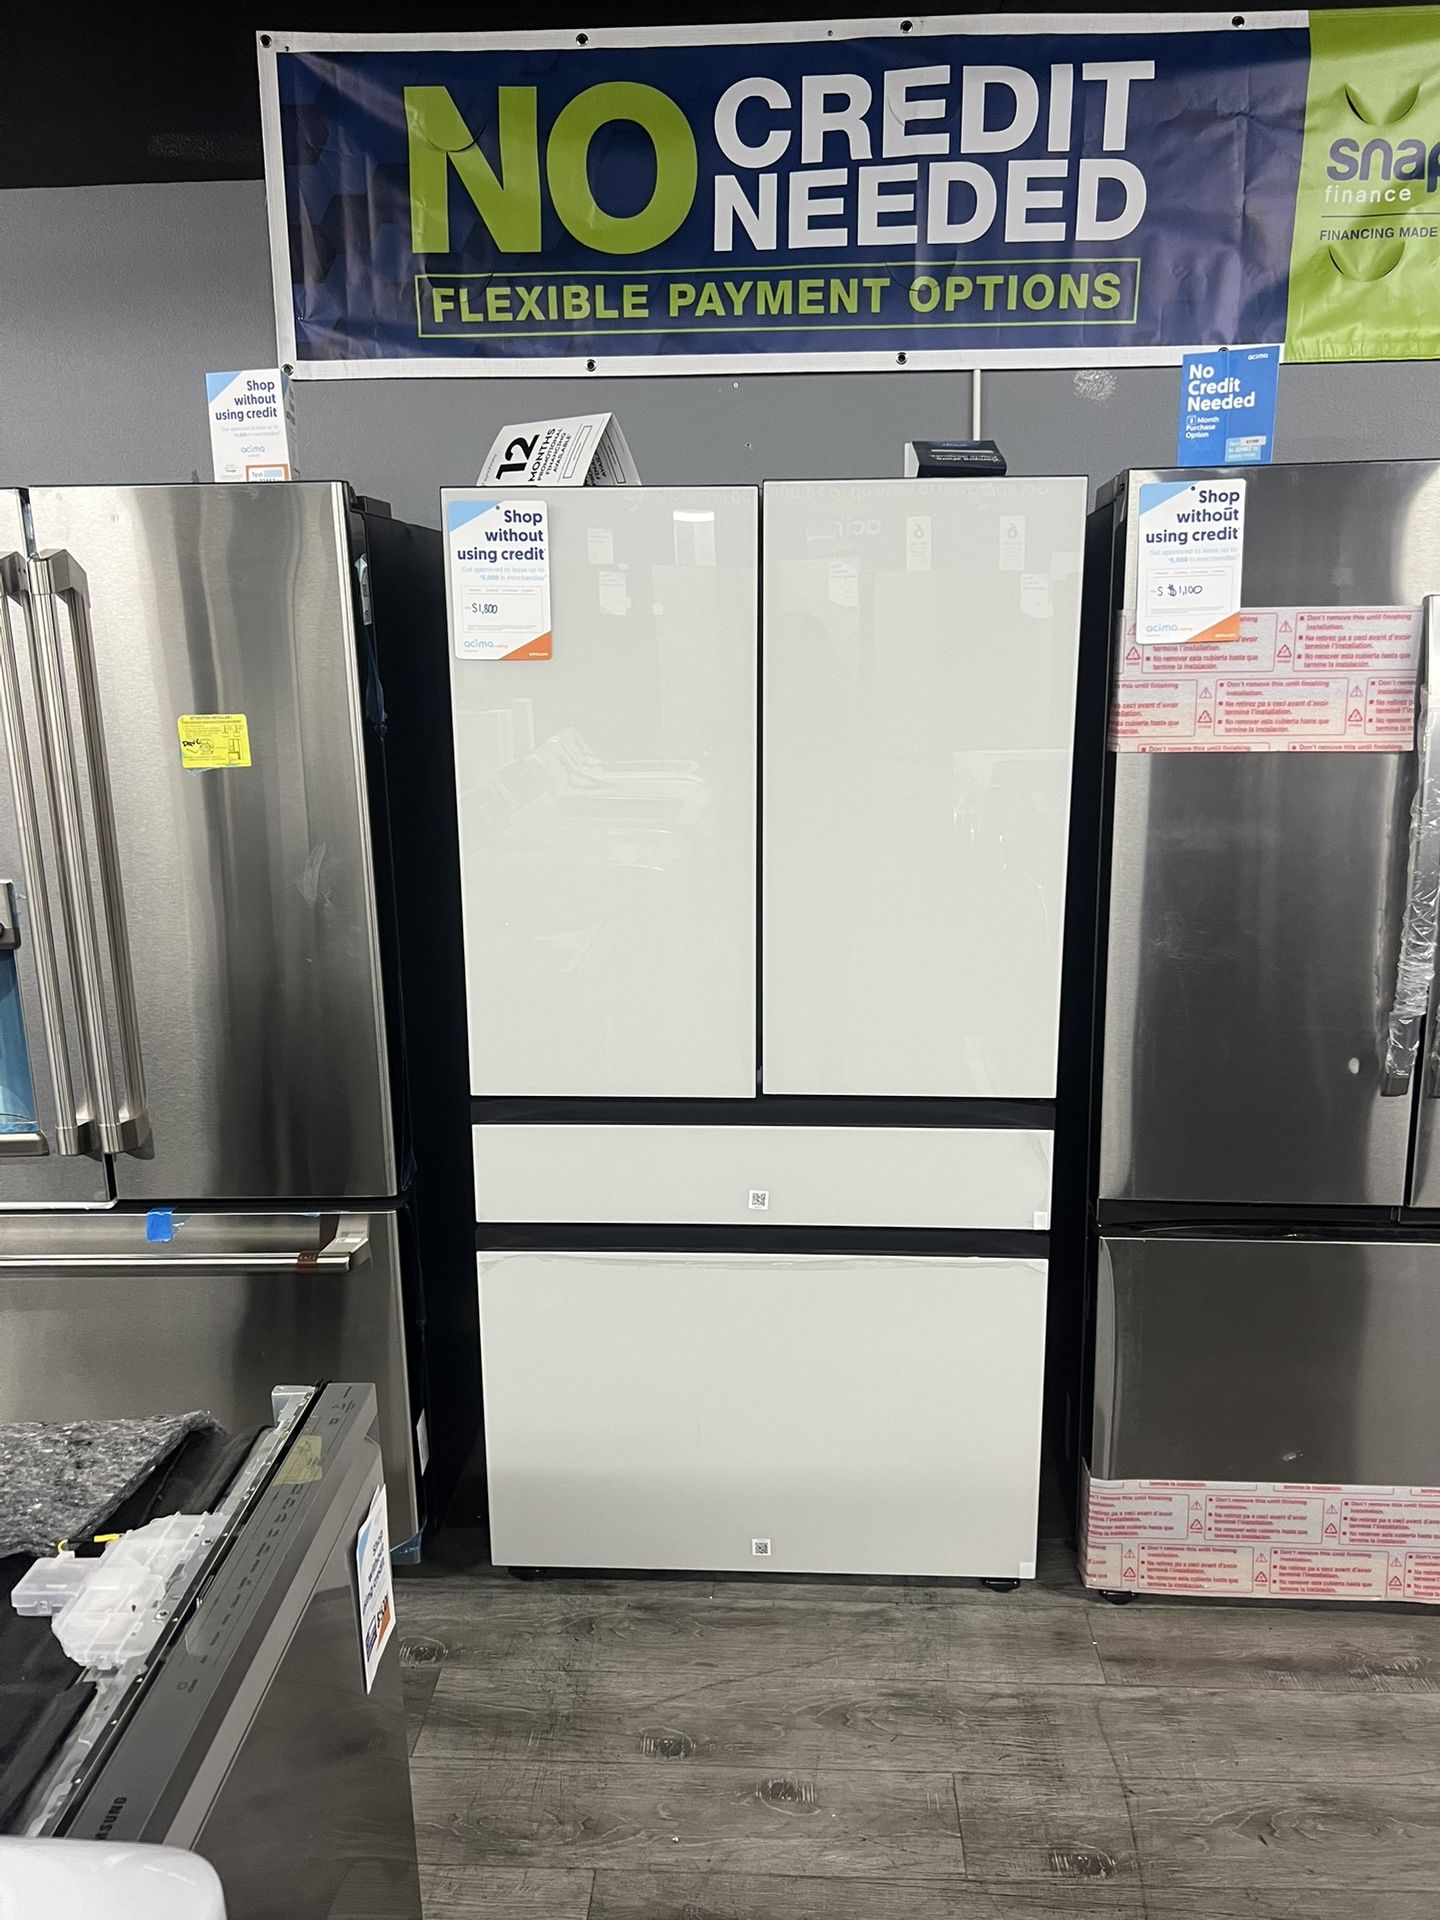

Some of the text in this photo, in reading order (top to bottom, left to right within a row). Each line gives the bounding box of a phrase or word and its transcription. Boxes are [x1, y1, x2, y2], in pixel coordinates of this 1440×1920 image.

[714, 60, 1156, 169] CREDIT
[404, 81, 698, 255] NO
[1325, 185, 1412, 203] finance
[714, 158, 1148, 252] NEEDED
[1320, 226, 1438, 241] FINANCING MADE
[432, 272, 1122, 324] FLEXIBLE PAYMENT OPTIONS
[1189, 363, 1215, 380] No
[246, 380, 275, 393] Shop
[1188, 377, 1241, 396] Credit
[234, 394, 277, 406] without
[1187, 391, 1256, 412] Needed
[215, 407, 278, 422] using credit
[240, 444, 265, 454] acima
[495, 434, 540, 480] 12
[528, 428, 556, 482] MONTHS
[1199, 490, 1240, 506] Shop
[504, 510, 543, 527] Shop
[1177, 509, 1239, 524] without
[485, 529, 544, 543] without
[1146, 527, 1239, 545] using credit
[457, 547, 544, 563] using credit
[1146, 623, 1177, 633] acima
[464, 638, 494, 649] acima
